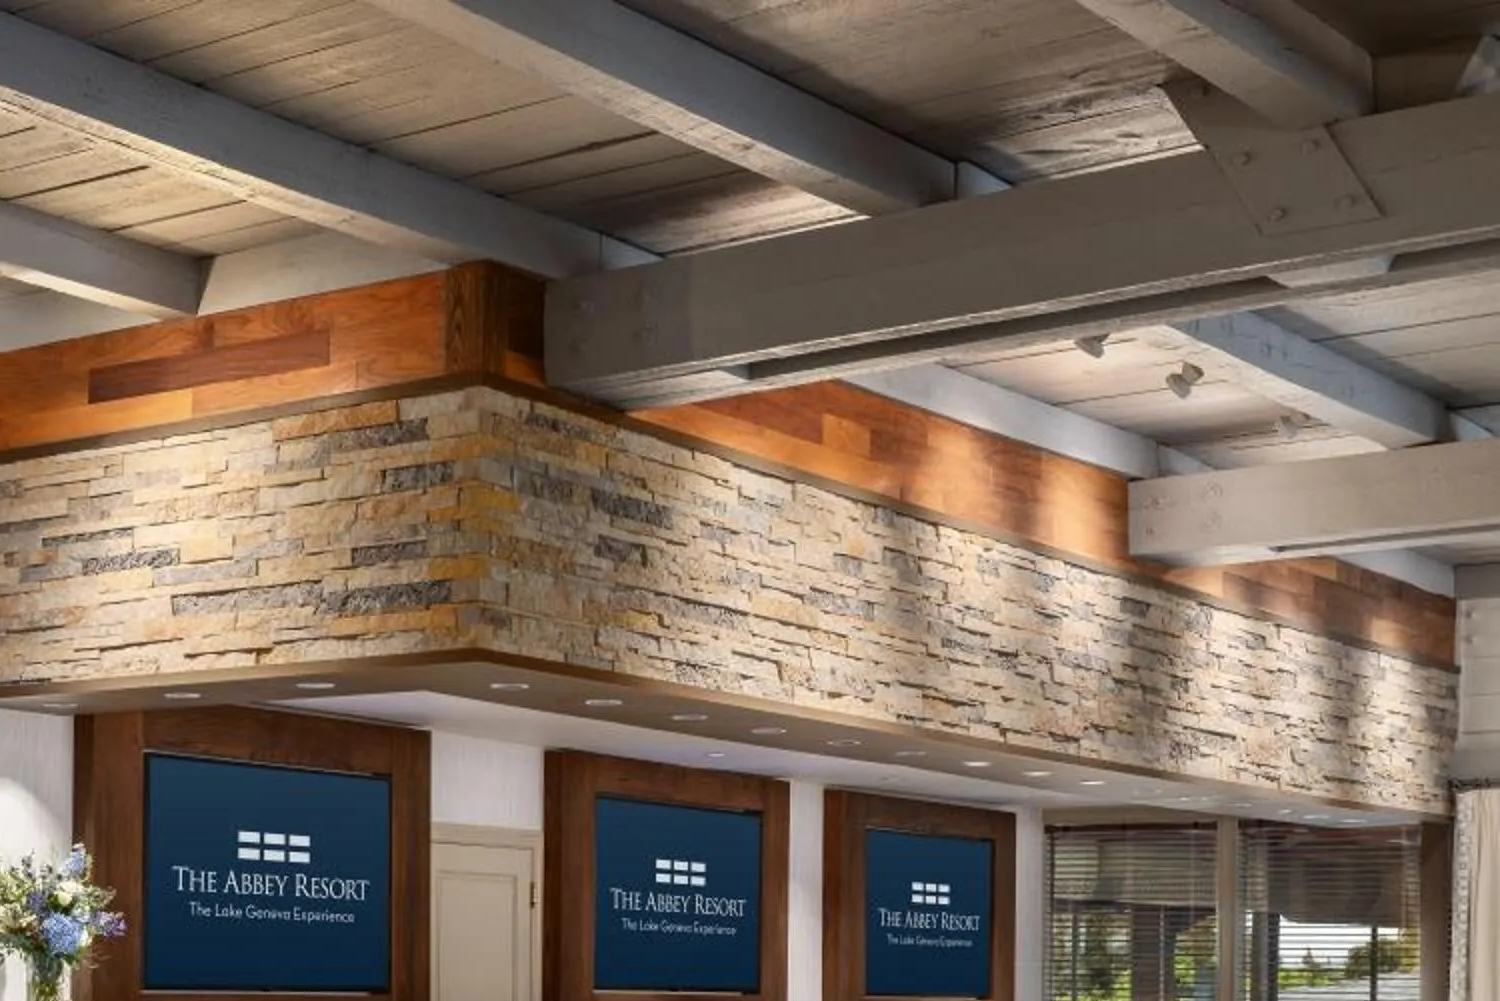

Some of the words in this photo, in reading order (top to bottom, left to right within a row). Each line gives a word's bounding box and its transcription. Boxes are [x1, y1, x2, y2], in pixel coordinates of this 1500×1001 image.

[172, 866, 217, 893] THE
[224, 871, 289, 897] ABBEY
[296, 873, 370, 901] RESORT
[189, 902, 211, 917] The
[215, 904, 243, 918] Lake
[246, 905, 291, 920] Geneva
[294, 907, 355, 923] Experience
[610, 888, 642, 911] THE
[645, 892, 691, 913] ABBEY
[695, 894, 746, 917] RESORT
[621, 918, 637, 930] The
[640, 919, 659, 931] Lake
[878, 908, 902, 927] THE
[904, 911, 939, 929] ABBEY
[941, 912, 980, 931] RESORT
